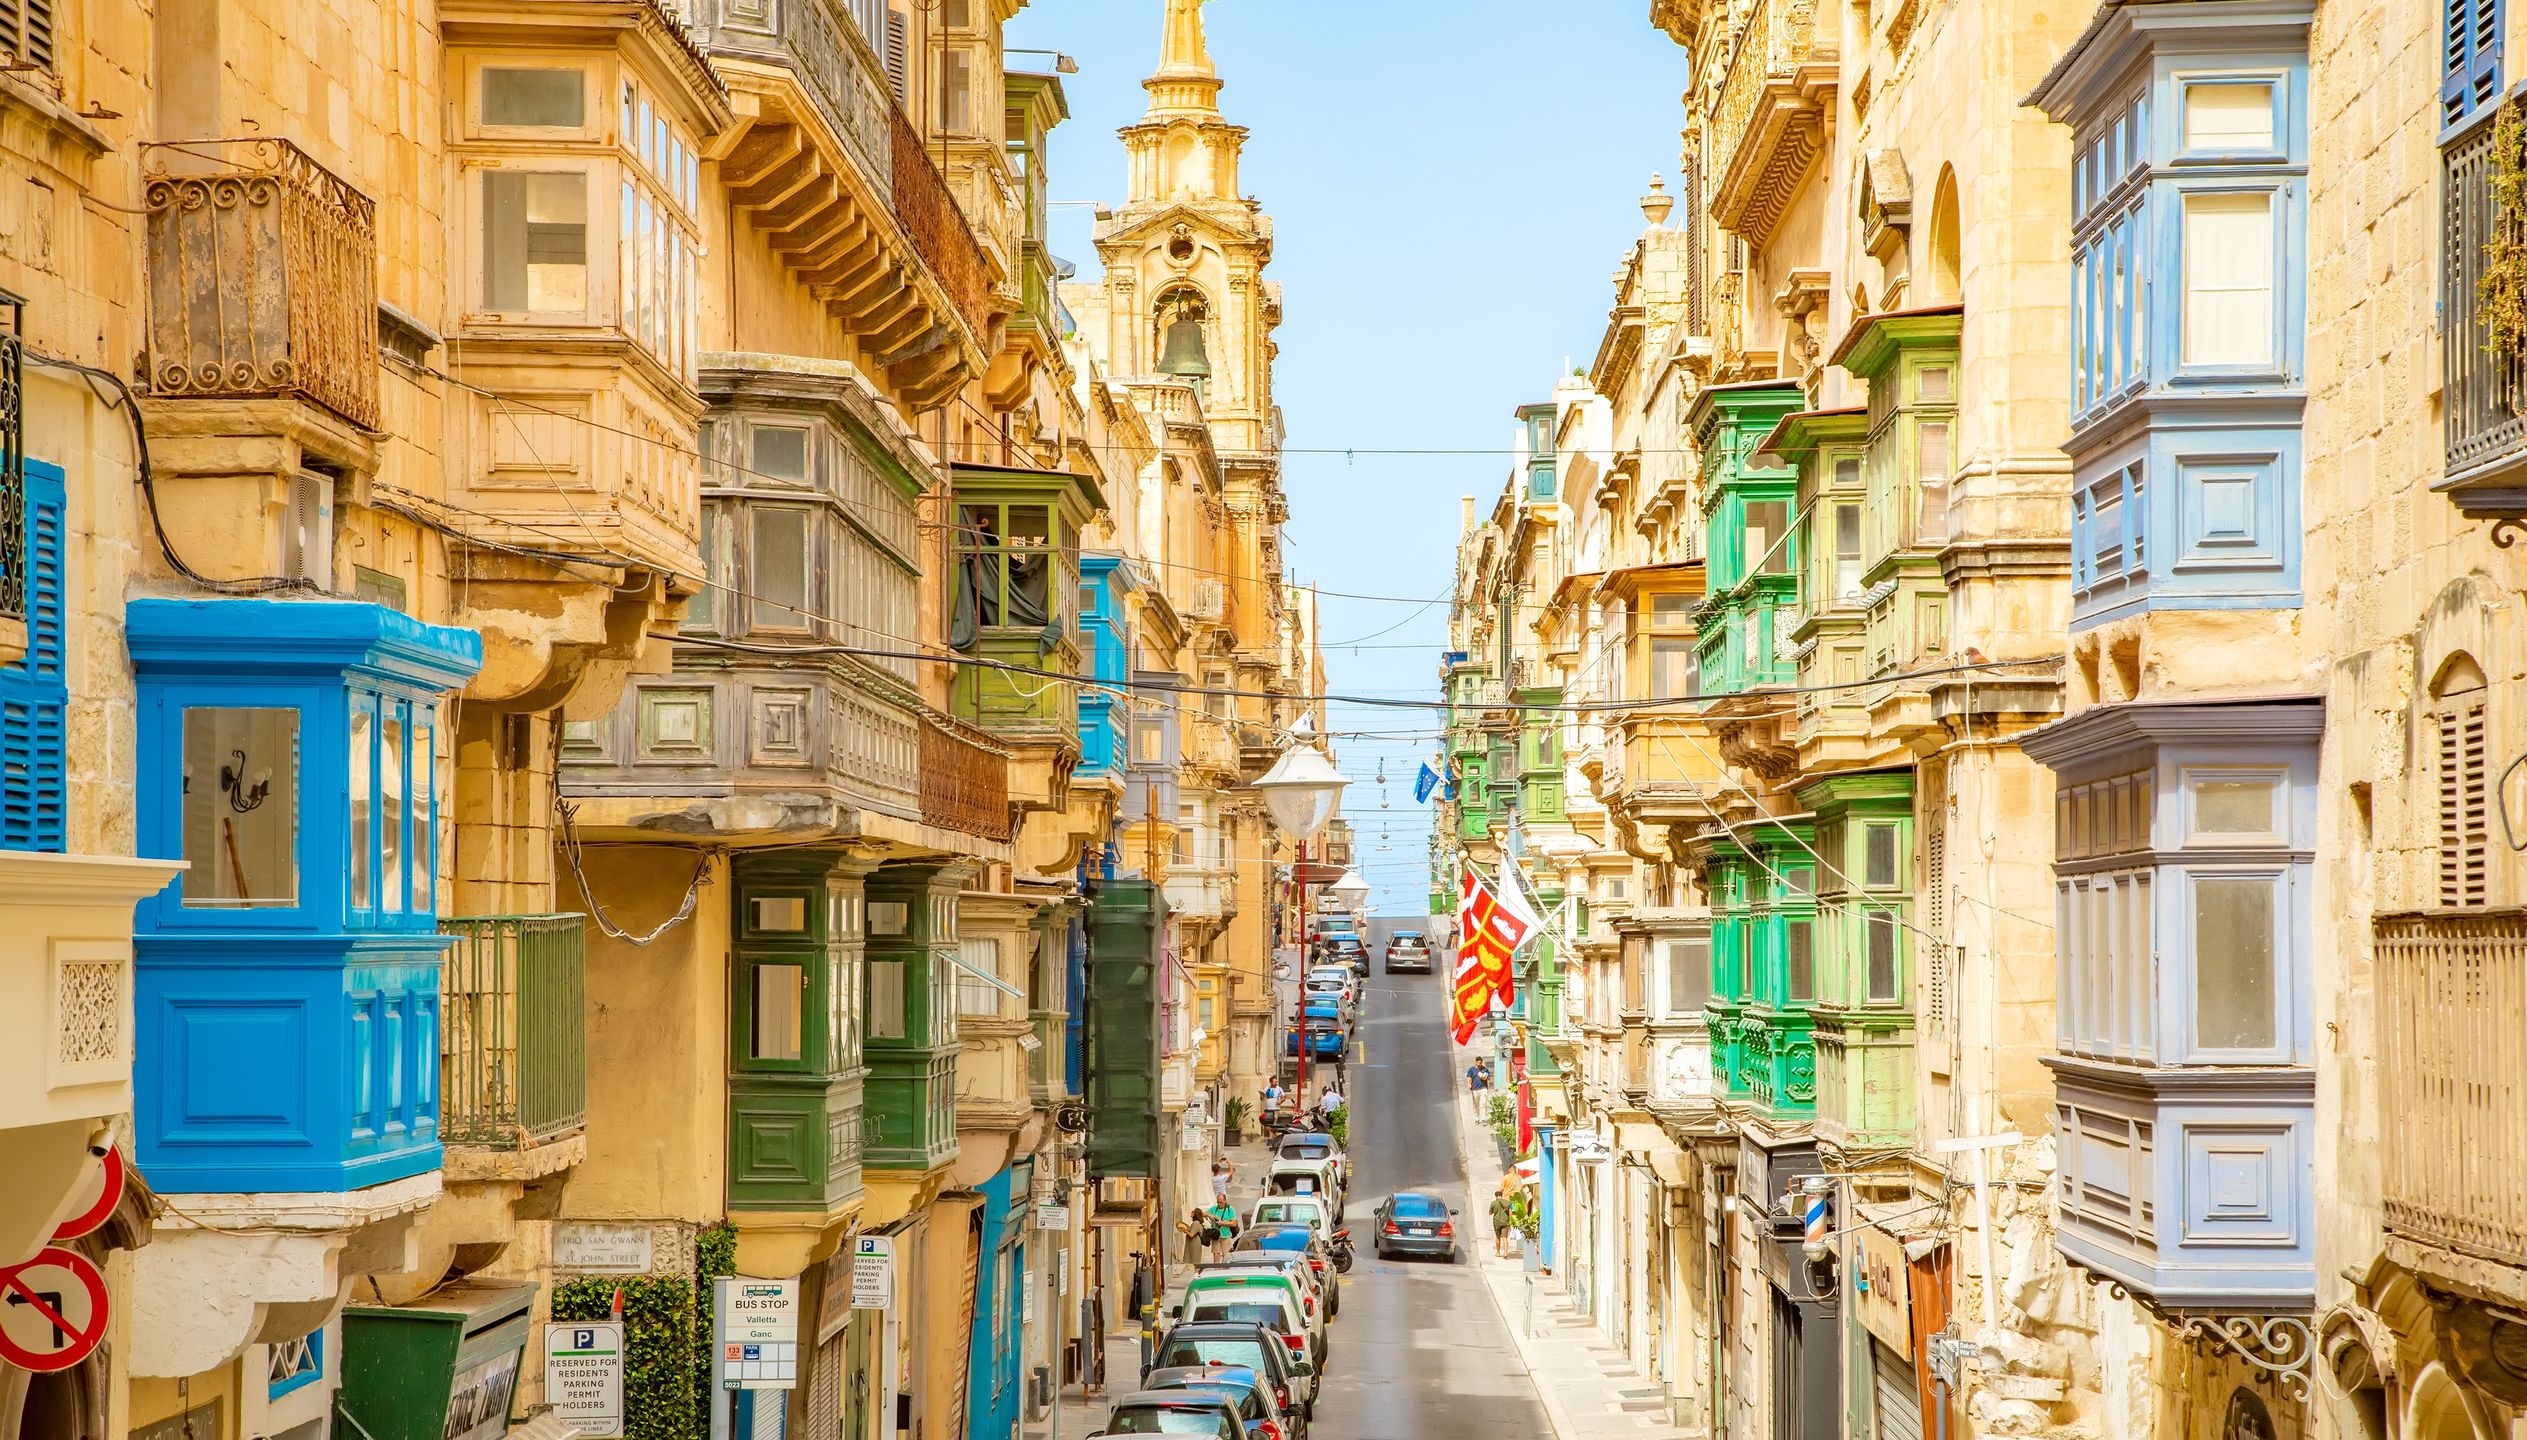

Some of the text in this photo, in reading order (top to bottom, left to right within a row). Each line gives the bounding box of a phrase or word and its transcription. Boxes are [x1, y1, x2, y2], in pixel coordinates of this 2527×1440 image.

[562, 1236, 582, 1245] TRIQ
[588, 1236, 605, 1244] SAN
[580, 1254, 604, 1264] JOHN
[609, 1254, 640, 1264] STREET
[735, 1299, 789, 1309] BUS STOP
[746, 1315, 777, 1324] Valletta
[750, 1330, 773, 1338] Ganc
[577, 1331, 591, 1348] P
[550, 1358, 618, 1368] RESERVED FOR
[558, 1369, 609, 1378] RESIDENTS
[563, 1379, 605, 1389] PARKING
[724, 1381, 741, 1389] 5023
[567, 1390, 601, 1399] PERMIT
[562, 1400, 605, 1410] HOLDERS
